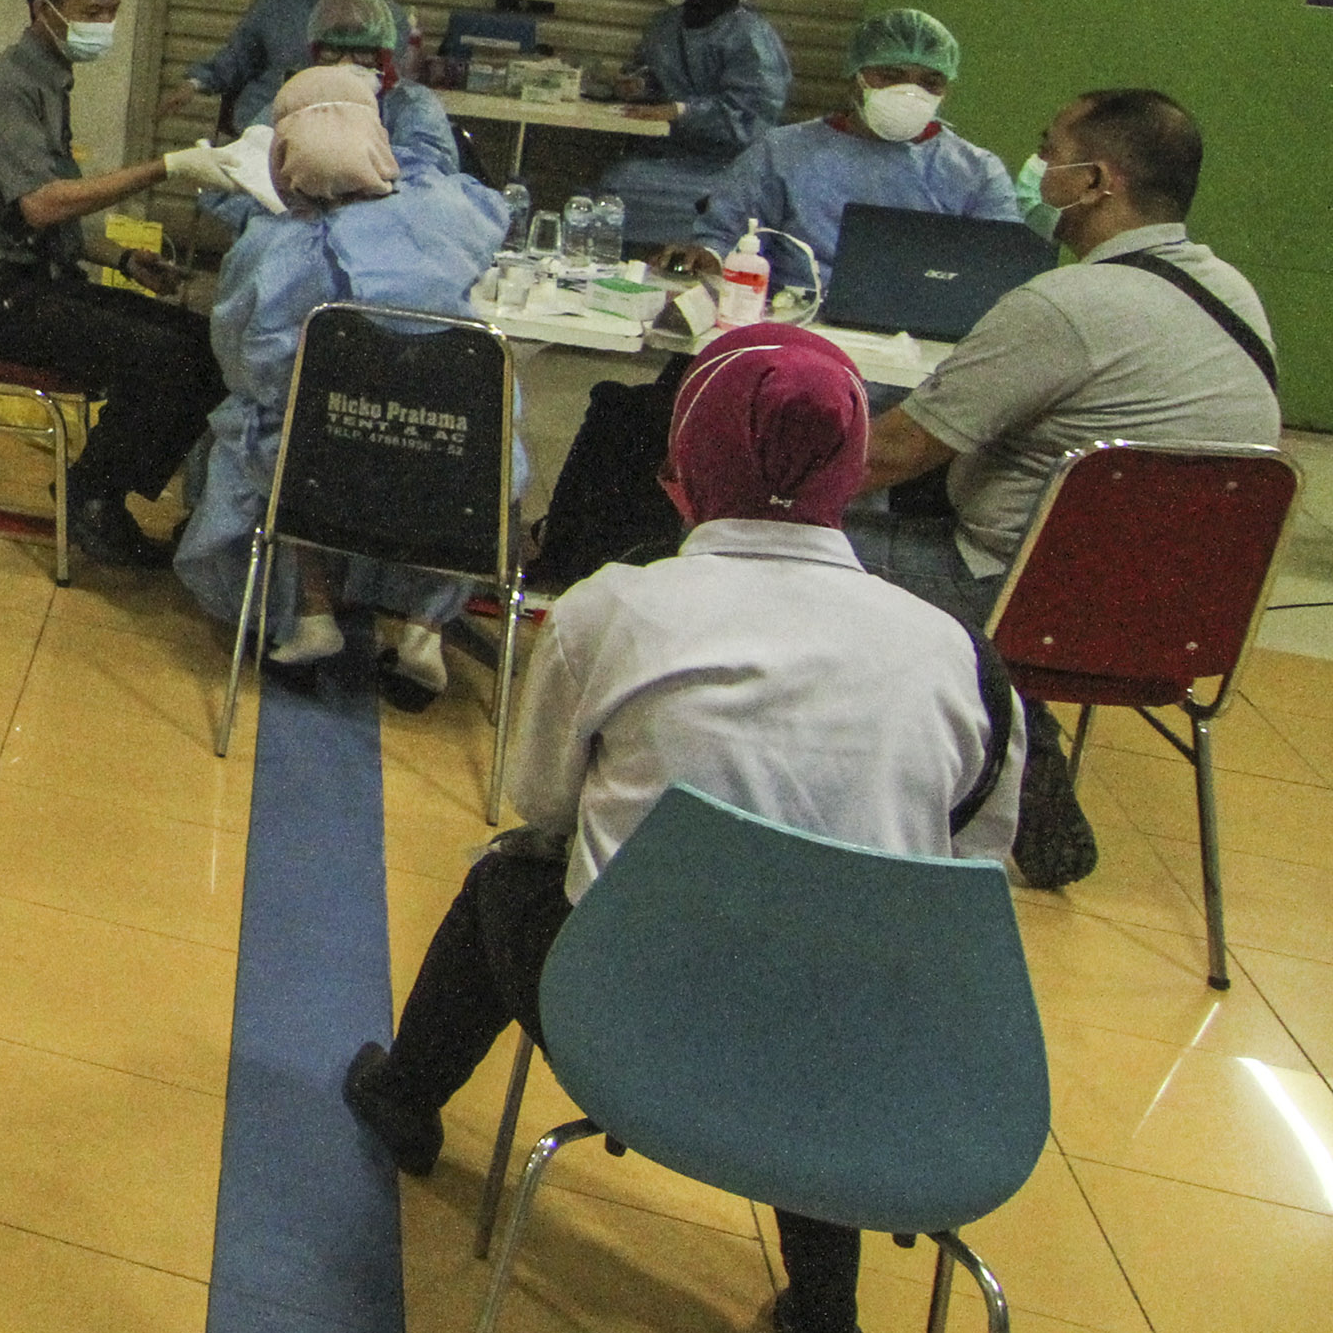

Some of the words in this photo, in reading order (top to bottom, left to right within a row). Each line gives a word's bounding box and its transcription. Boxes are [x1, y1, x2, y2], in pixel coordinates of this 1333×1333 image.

[327, 413, 389, 432] TENT
[433, 431, 466, 443] AC
[386, 401, 468, 431] Pratama
